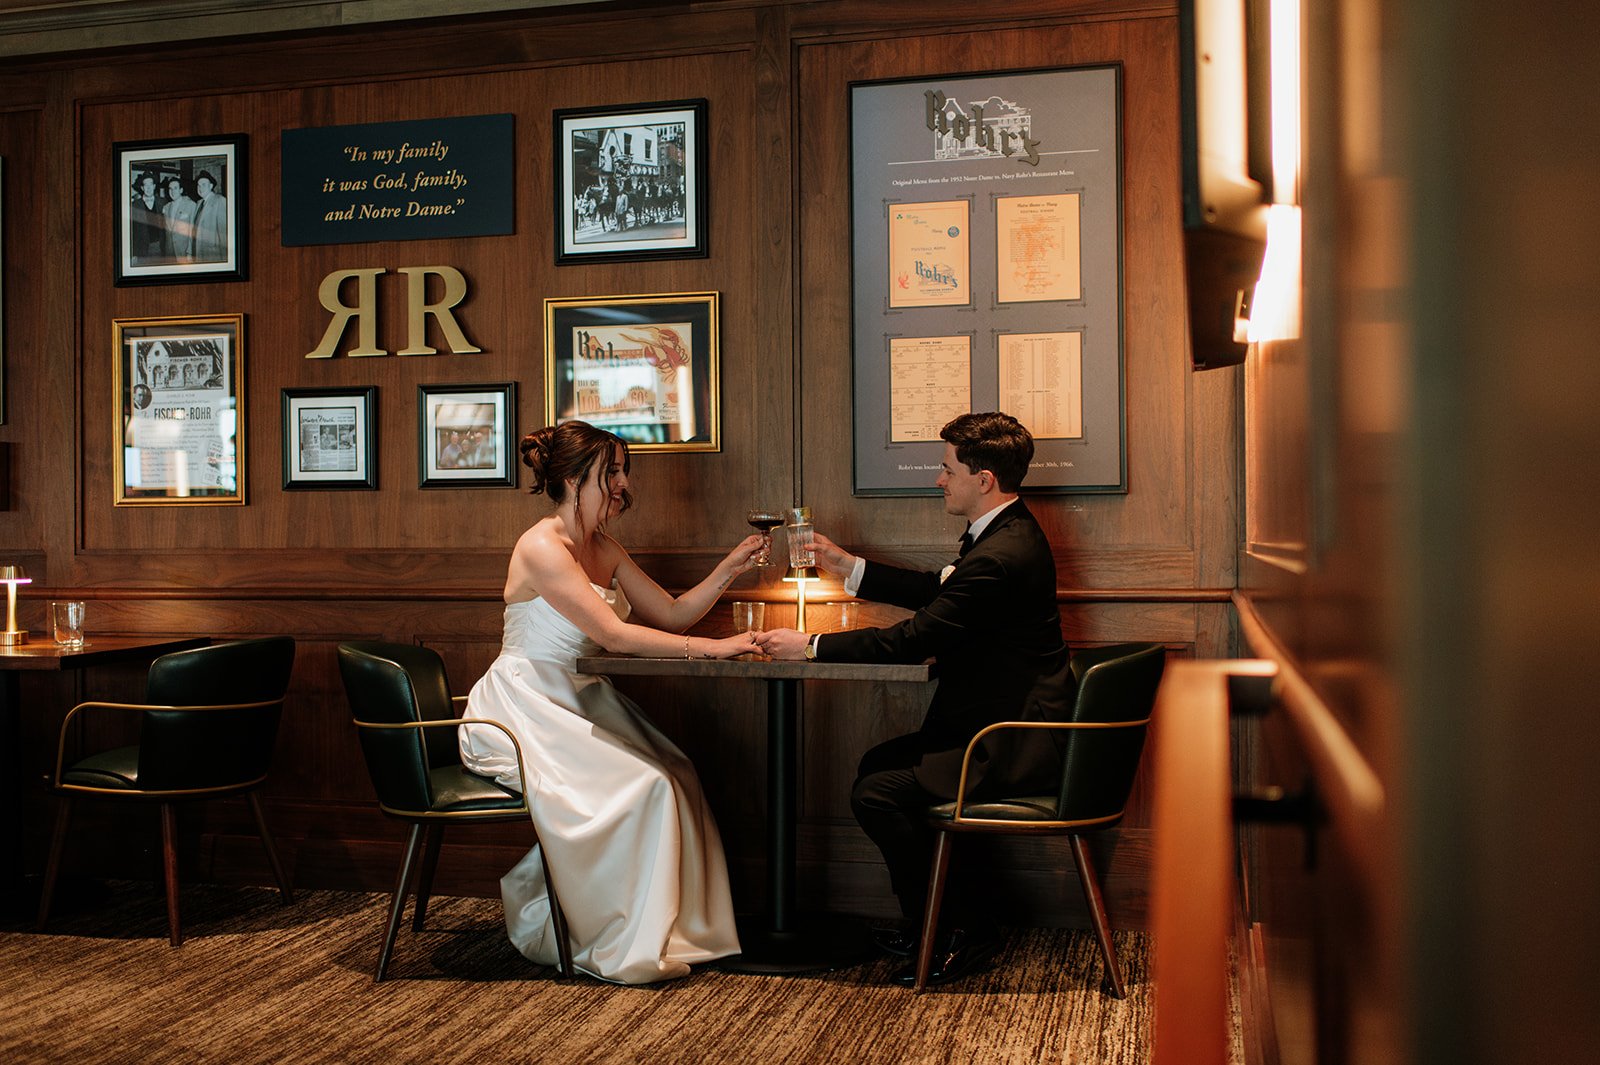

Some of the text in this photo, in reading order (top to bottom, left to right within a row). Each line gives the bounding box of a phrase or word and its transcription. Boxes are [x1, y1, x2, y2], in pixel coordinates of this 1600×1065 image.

[372, 148, 395, 165] my
[395, 140, 449, 164] family
[322, 169, 467, 192] it was God, family,
[324, 204, 356, 222] and
[358, 203, 401, 220] Notre
[154, 406, 212, 420] FISCH-ROHR
